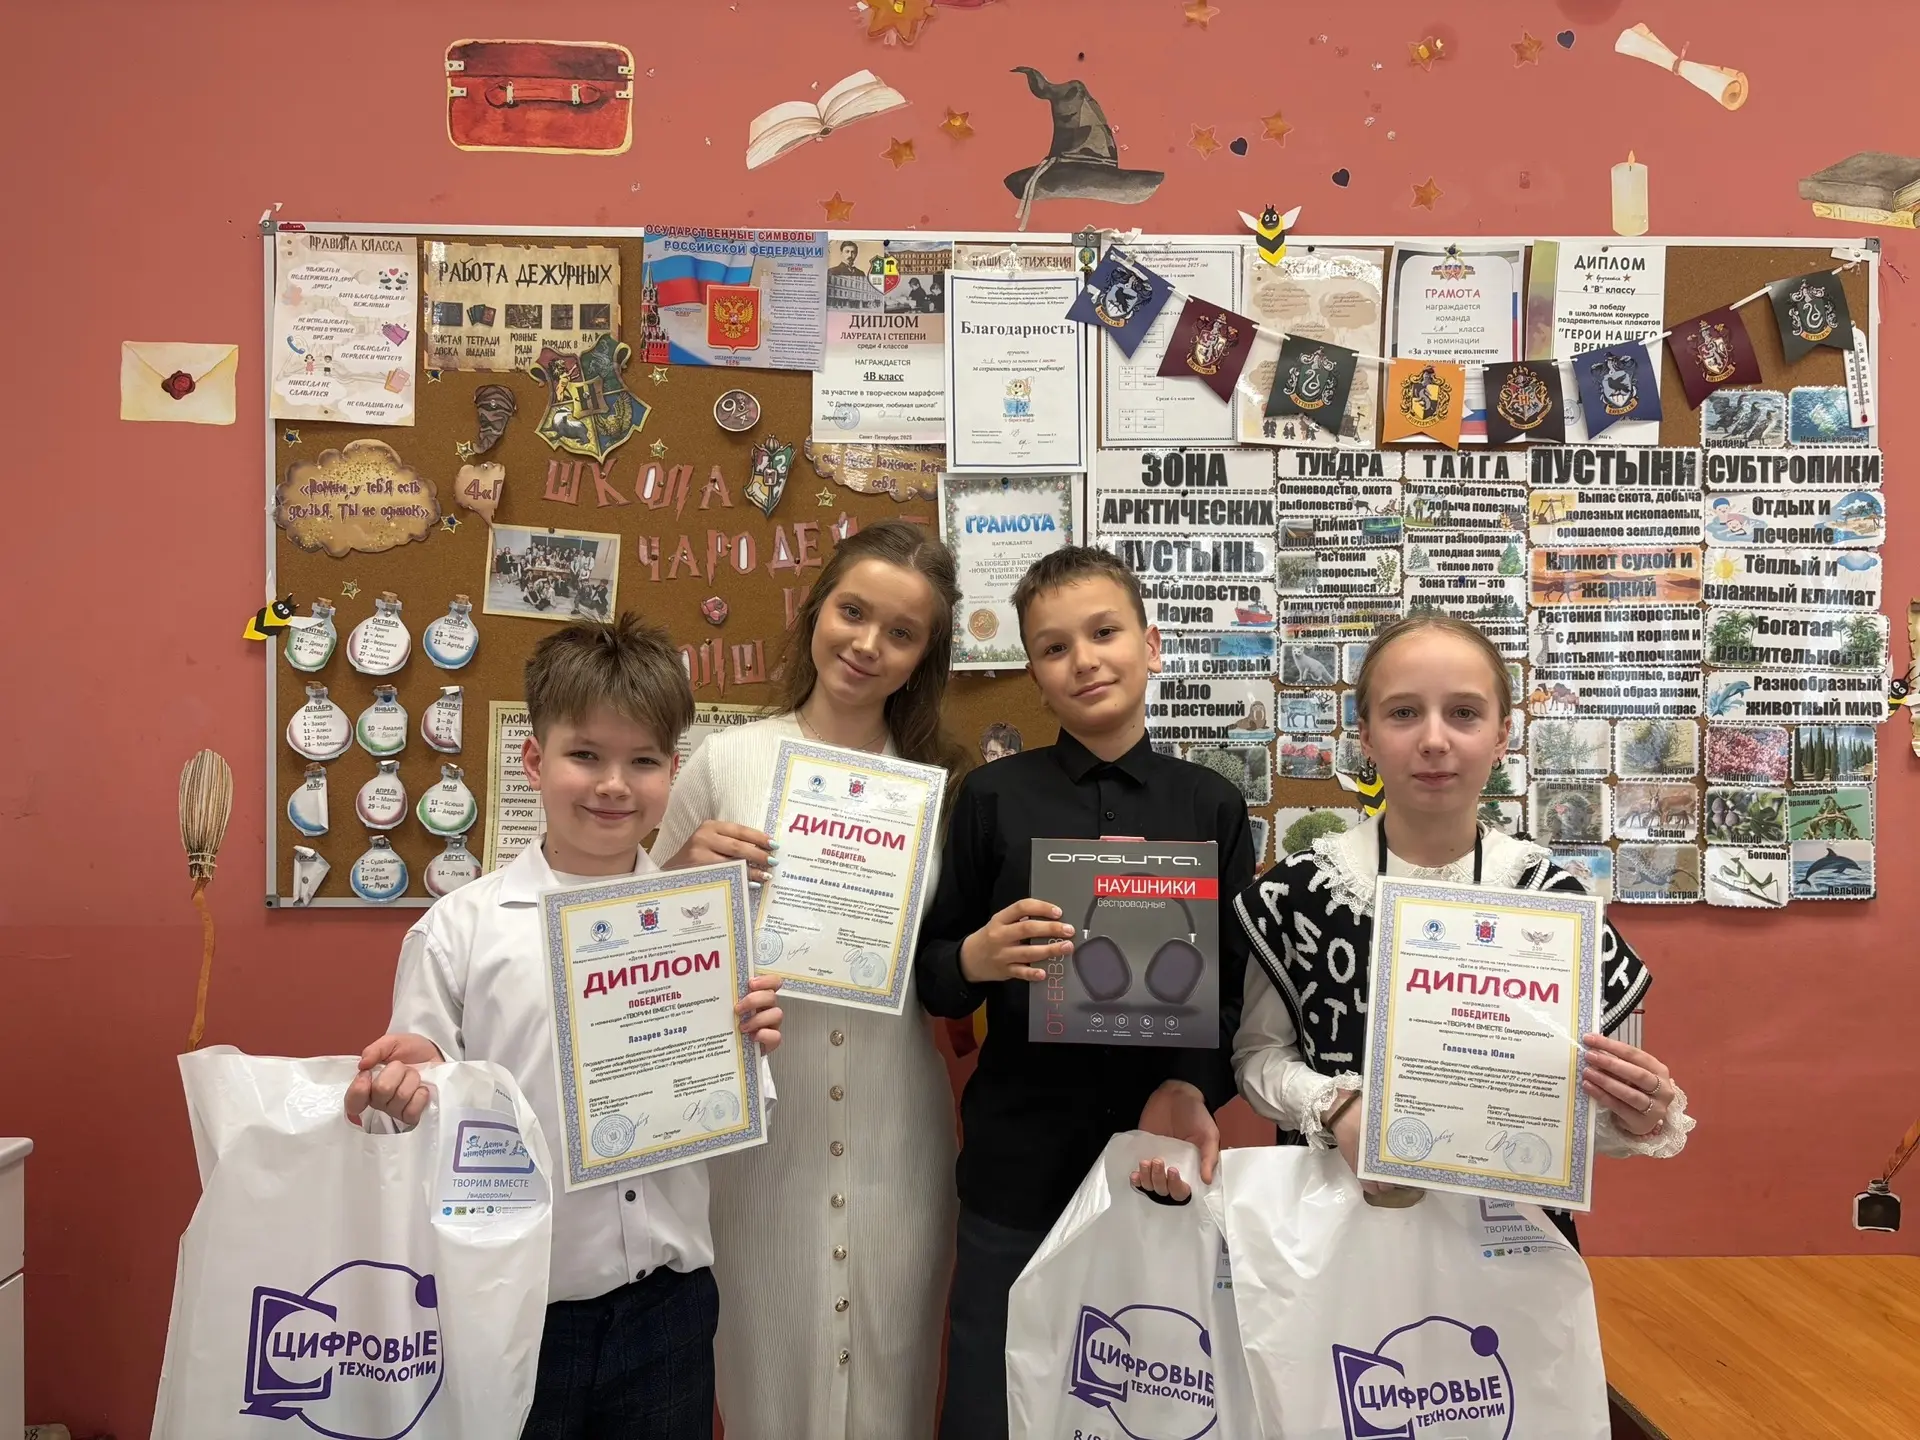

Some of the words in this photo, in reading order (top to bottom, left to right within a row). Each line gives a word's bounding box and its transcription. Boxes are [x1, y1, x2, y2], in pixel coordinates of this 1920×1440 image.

[310, 235, 357, 251] ПРАВИЛА
[361, 238, 403, 252] КЛАССА
[758, 231, 816, 242] СИМВОЛЫ
[663, 240, 747, 255] РОССИЙСКОЙ
[750, 244, 824, 258] ФЕДЕРАЦИИ
[1574, 255, 1646, 271] ДИПЛОМ
[439, 257, 508, 287] РАБОТА
[515, 261, 612, 291] ДЕЖУРНЫХ
[1425, 288, 1481, 299] ГРАМОТА
[1605, 286, 1636, 295] классу
[1425, 302, 1481, 311] награждается
[1600, 304, 1626, 312] победу
[1436, 314, 1471, 323] команда
[1575, 310, 1614, 319] школьном
[1616, 311, 1649, 319] конкурсе
[849, 315, 919, 329] ДИПЛОМ
[961, 320, 1075, 338] Благодарность
[1558, 318, 1623, 326] поздравительных
[840, 332, 881, 340] ЛАУРЕАТА
[1459, 325, 1485, 334] класса
[1558, 328, 1603, 340] "ГЕРОИ
[1606, 330, 1658, 341] НАШЕГО
[466, 335, 500, 346] ТЕТРАДИ
[510, 333, 538, 342] РОВНЫЕ
[1434, 337, 1480, 346] номинации
[515, 346, 532, 355] РЯДЫ
[1424, 349, 1450, 357] лучшее
[1453, 347, 1498, 355] исполнение
[879, 373, 904, 381] класс
[1705, 437, 1749, 448] Бакланы
[1141, 452, 1228, 487] ЗОНА
[1296, 452, 1384, 480] ТУНДРА
[1423, 454, 1510, 480] ТАЙГА
[1531, 448, 1696, 486] ПУСТЫНИ
[1709, 454, 1880, 484] СУБТРОПИКИ
[542, 459, 735, 521] ШКОЛА
[1279, 483, 1360, 497] Оленеводство,
[1362, 484, 1392, 495] охота
[1578, 492, 1616, 503] Выпас
[1618, 493, 1654, 503] скота,
[1656, 491, 1702, 504] добыча
[1102, 498, 1274, 525] АРКТИЧЕСКИХ
[1279, 499, 1353, 511] рыболовство
[1428, 499, 1470, 513] добыча
[1472, 501, 1526, 513] полезных
[1752, 496, 1816, 518] Отдых
[1566, 509, 1624, 520] полезных
[1626, 508, 1702, 520] ископаемых,
[965, 514, 1055, 534] ГРАМОТА
[1313, 517, 1363, 532] Климат
[1433, 517, 1501, 529] ископаемых
[1557, 526, 1624, 538] орошаемое
[1626, 525, 1700, 537] земледелие
[1753, 527, 1834, 544] лечение
[1407, 534, 1444, 544] Климат
[1445, 533, 1523, 545] разнообразный:
[1114, 540, 1265, 573] ПУСТЫНЬ
[1315, 551, 1366, 562] Растения
[1428, 548, 1474, 558] холодная
[1546, 551, 1618, 570] Климат
[1622, 549, 1676, 571] сухой
[1744, 554, 1821, 576] Тёплый
[1581, 576, 1657, 599] жаркий
[1704, 583, 1797, 603] влажный
[1801, 590, 1876, 606] климат
[1347, 600, 1393, 610] оперение
[1410, 593, 1464, 605] дремучие
[1466, 593, 1514, 604] хвойные
[1157, 603, 1214, 624] Наука
[1538, 610, 1602, 623] Растения
[1605, 609, 1700, 622] низкорослые
[372, 617, 399, 628] ОКТЯБРЬ
[1757, 615, 1833, 637] Богатая
[1567, 630, 1634, 645] длинным
[1637, 629, 1690, 642] корнем
[1546, 650, 1700, 664] листьями-колючками
[1716, 646, 1873, 666] растительность
[1202, 656, 1271, 673] суровый
[1535, 668, 1595, 681] Животные
[1598, 669, 1665, 682] некрупные,
[1668, 670, 1700, 682] ведут
[1160, 681, 1211, 700] Мало
[1754, 675, 1882, 692] Разнообразный
[1579, 685, 1620, 698] ночной
[1623, 686, 1657, 698] образ
[1172, 701, 1245, 717] растений
[1575, 703, 1660, 715] маскирующий
[1662, 704, 1696, 716] окрас
[1745, 698, 1841, 716] животный
[1845, 701, 1882, 717] мир
[1150, 726, 1229, 740] животных
[442, 784, 457, 792] МАЙ
[501, 798, 537, 807] перемена
[788, 813, 906, 851] ДИПЛОМ
[1647, 827, 1685, 838] Сайгаки
[1730, 834, 1762, 844] Инжир
[443, 853, 466, 861] АВГУСТ
[821, 848, 867, 863] ПОБЕДИТЕЛЬ
[1748, 851, 1787, 860] Богомол
[781, 870, 818, 884] Завьялова
[819, 880, 840, 888] Алина
[842, 882, 895, 899] Александровна
[1097, 878, 1196, 895] НАУШНИКИ
[1827, 886, 1871, 896] Дельфин
[1620, 889, 1656, 899] Ящерка
[1658, 889, 1698, 899] быстрая
[1097, 898, 1166, 909] беспроводные
[583, 950, 721, 998] ДИПЛОМ
[1406, 968, 1559, 1003] ДИПЛОМ
[628, 991, 682, 1009] ПОБЕДИТЕЛЬ
[652, 1004, 676, 1016] ВМЕСТЕ
[1451, 1007, 1511, 1023] ПОБЕДИТЕЛЬ
[628, 1029, 661, 1044] Лазарев
[663, 1025, 687, 1037] Захар
[1476, 1024, 1503, 1032] ВМЕСТЕ
[1442, 1043, 1488, 1056] Головчева
[1491, 1049, 1515, 1059] Юлия
[483, 1141, 503, 1150] Дети
[463, 1149, 506, 1157] интернете
[453, 1179, 491, 1187] ТВОРИМ
[494, 1179, 529, 1187] ВМЕСТЕ
[1484, 1225, 1523, 1234] ТВОРИМ
[272, 1330, 437, 1363] ЦИФРОВЫЕ
[338, 1361, 436, 1382] ТЕХНОЛОГИИ
[1090, 1339, 1214, 1395] ЦИФРОВЫЕ
[1131, 1380, 1215, 1408] ТЕХНОЛОГИИ
[1358, 1375, 1502, 1410] ЦИФРОВЫЕ
[1416, 1403, 1505, 1428] ТЕХНОЛОГИИ
